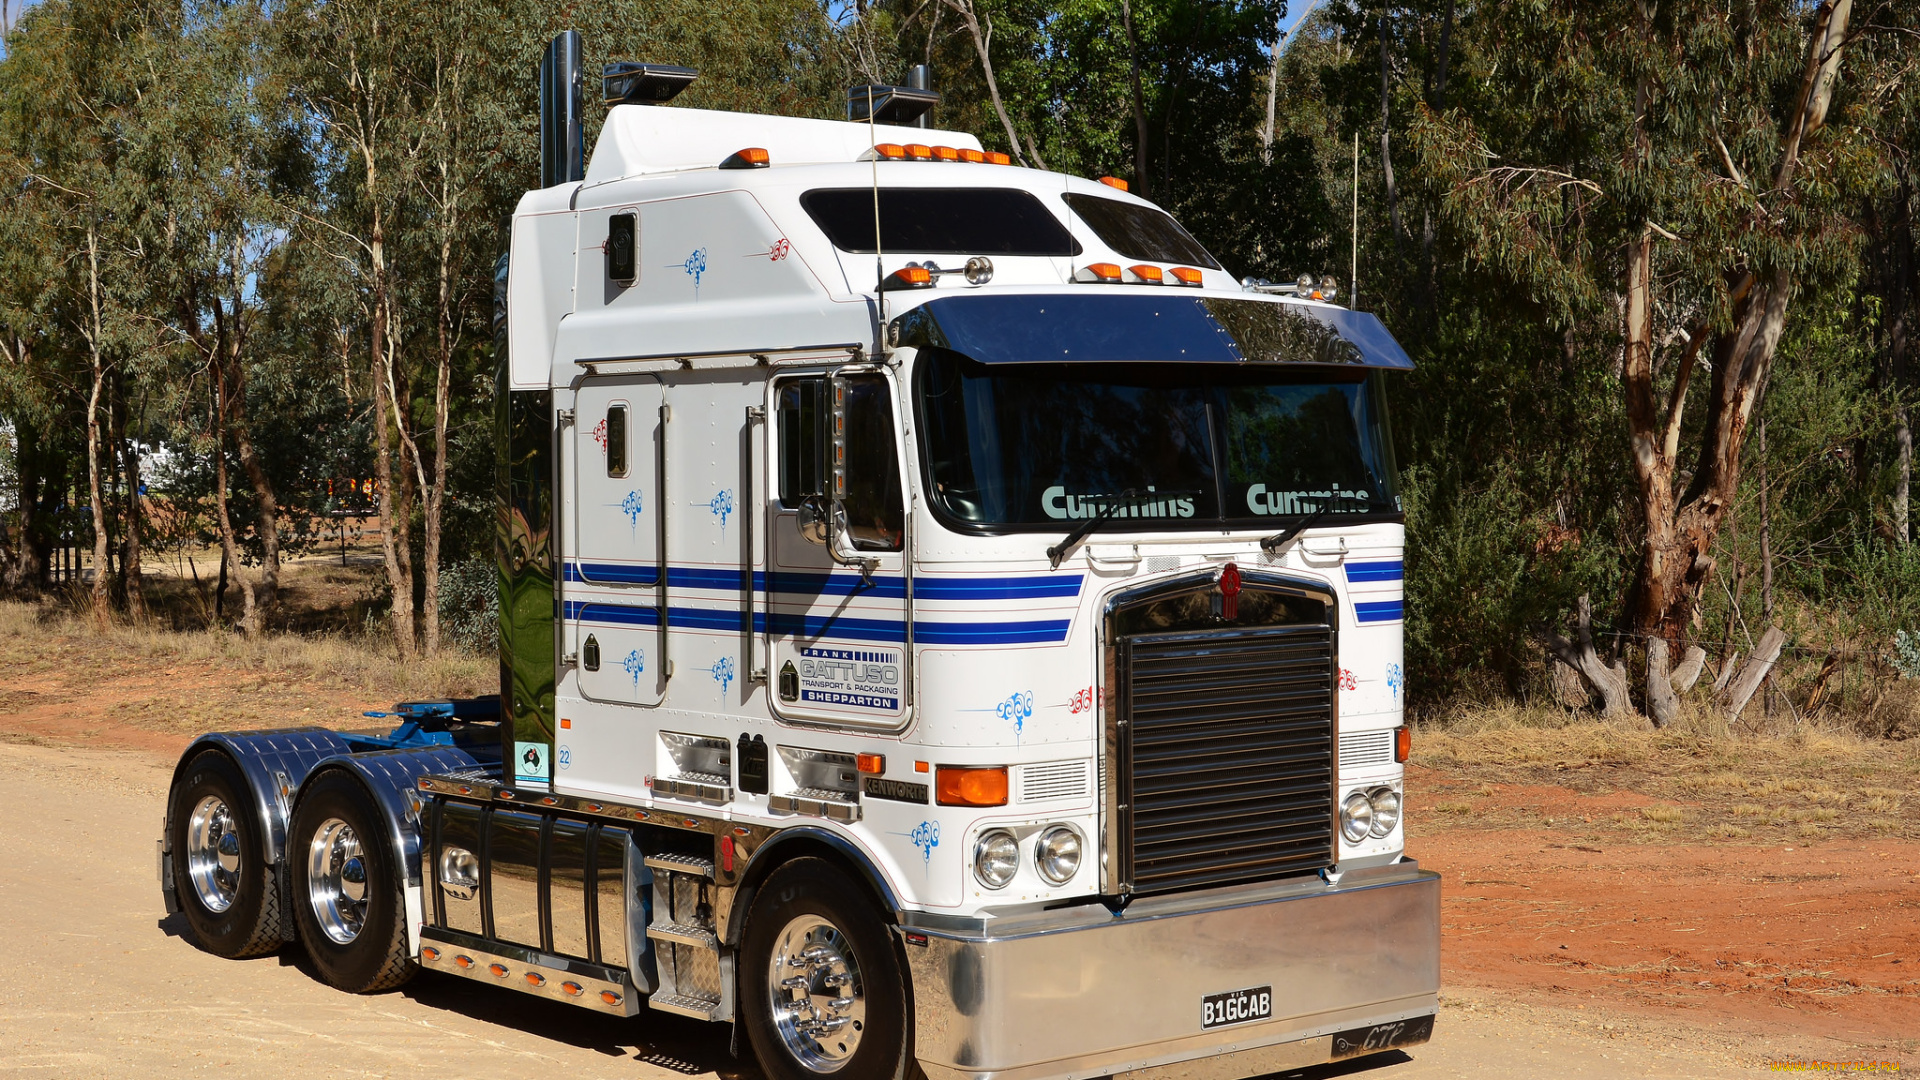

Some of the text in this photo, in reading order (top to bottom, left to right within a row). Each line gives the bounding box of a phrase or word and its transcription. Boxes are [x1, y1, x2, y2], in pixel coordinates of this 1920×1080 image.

[803, 648, 849, 659] FRANK
[800, 659, 899, 685] GATTUSO
[802, 679, 899, 696] TRANSPORT & PACKAGING
[808, 689, 892, 708] SHEPPARTON
[559, 749, 570, 765] 22
[864, 778, 928, 801] KENWORTH
[1230, 991, 1245, 999] VIC
[1203, 992, 1271, 1026] B1GCAB
